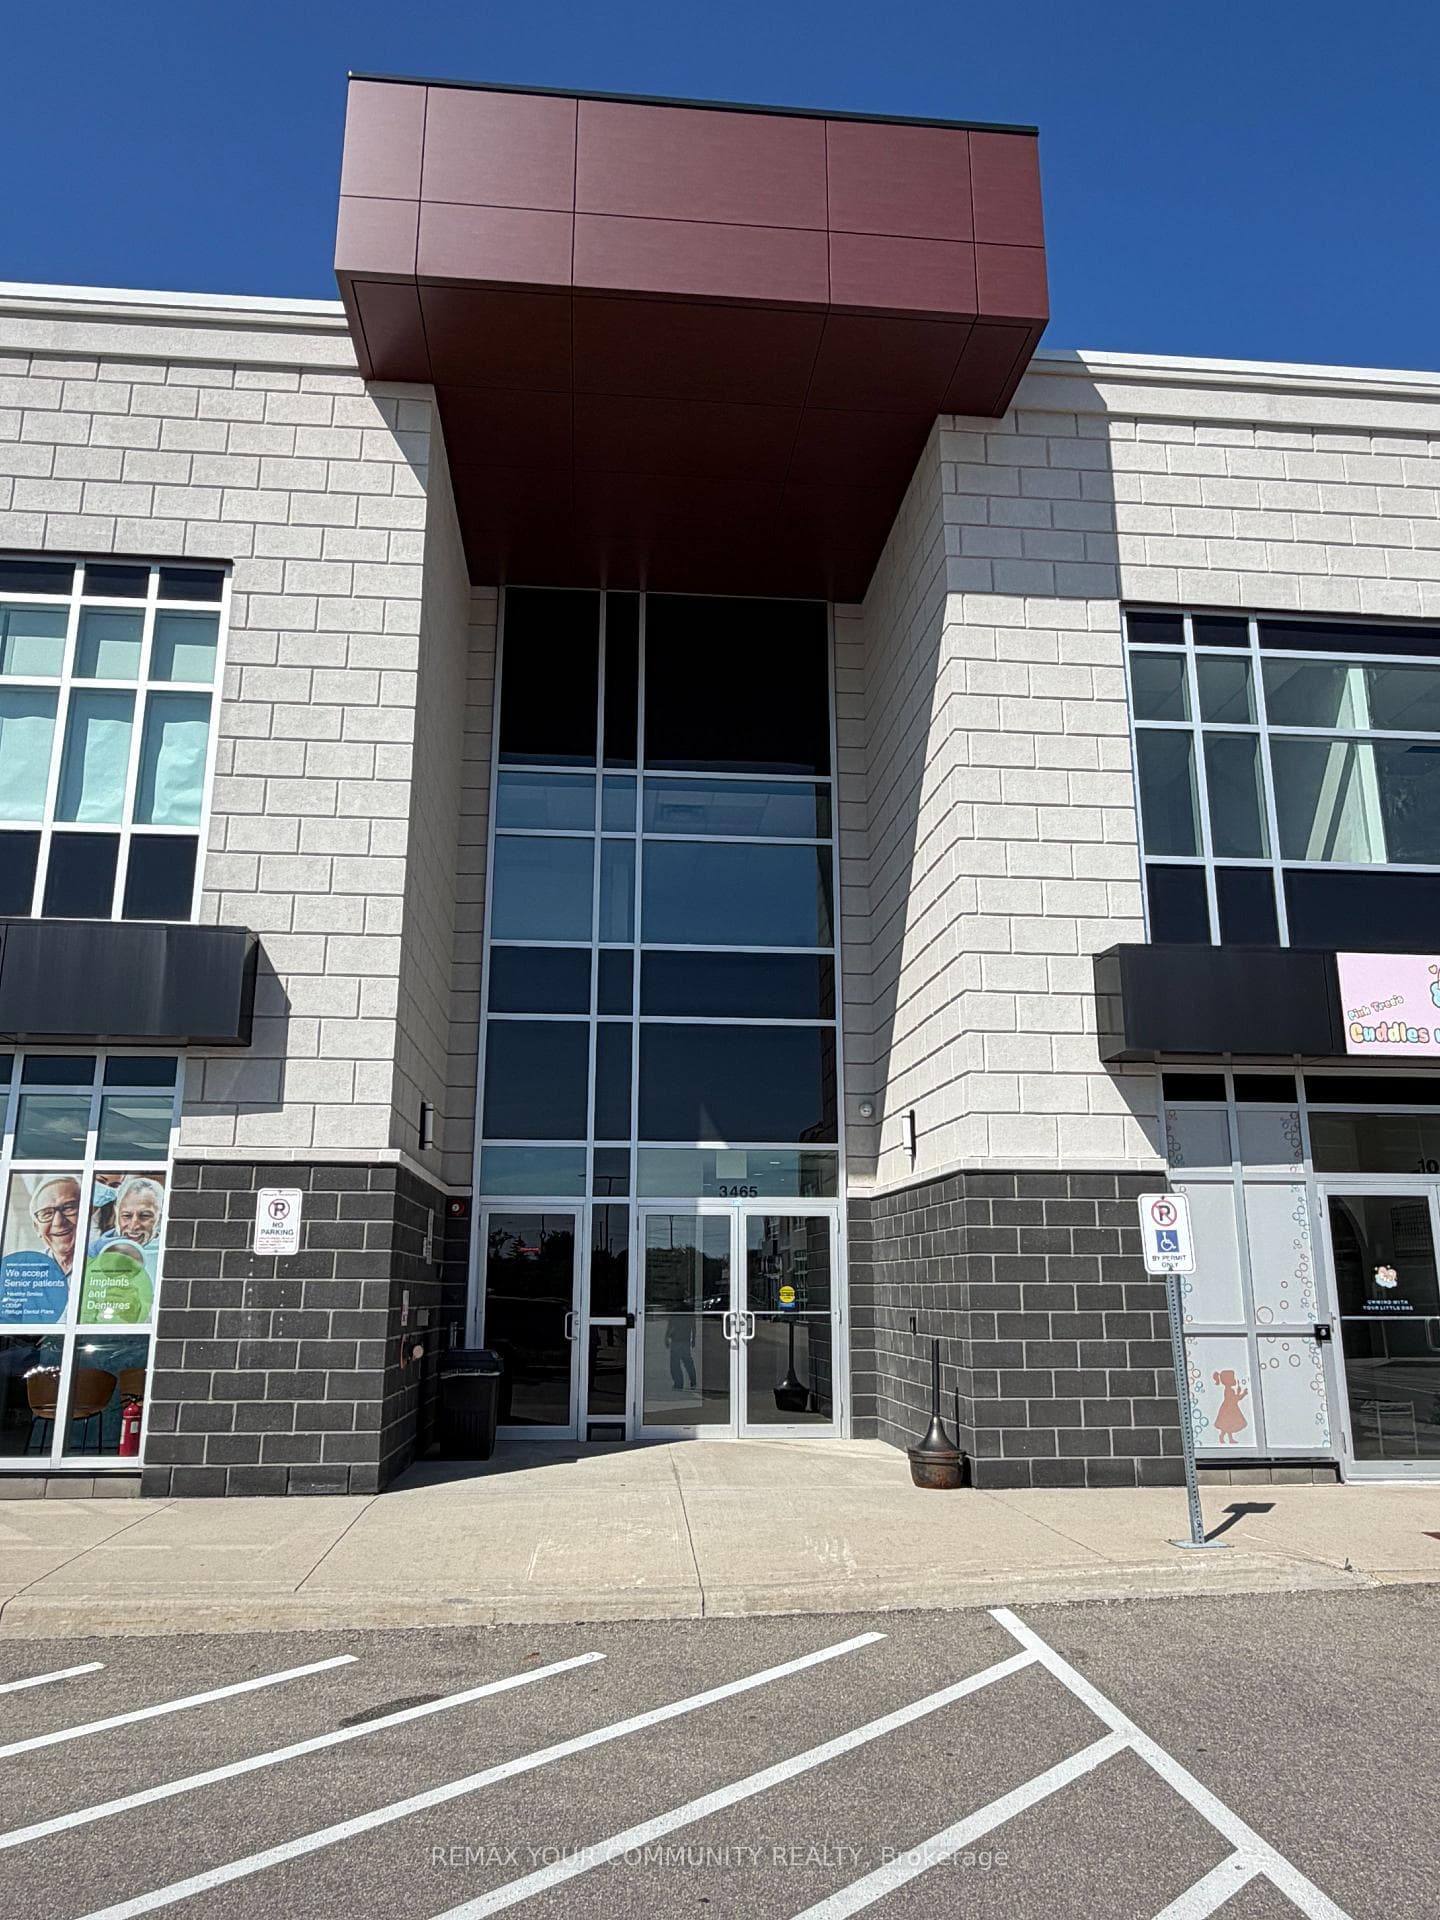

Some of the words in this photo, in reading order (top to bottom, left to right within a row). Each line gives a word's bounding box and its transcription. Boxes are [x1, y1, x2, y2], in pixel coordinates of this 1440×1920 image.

[1349, 1021, 1430, 1043] Cuddles
[719, 1185, 758, 1198] 3465
[5, 1269, 20, 1277] We
[21, 1270, 49, 1279] accept
[4, 1279, 31, 1287] Senior
[32, 1279, 65, 1288] patients
[90, 1277, 130, 1288] Implants
[87, 1301, 131, 1310] Dentures
